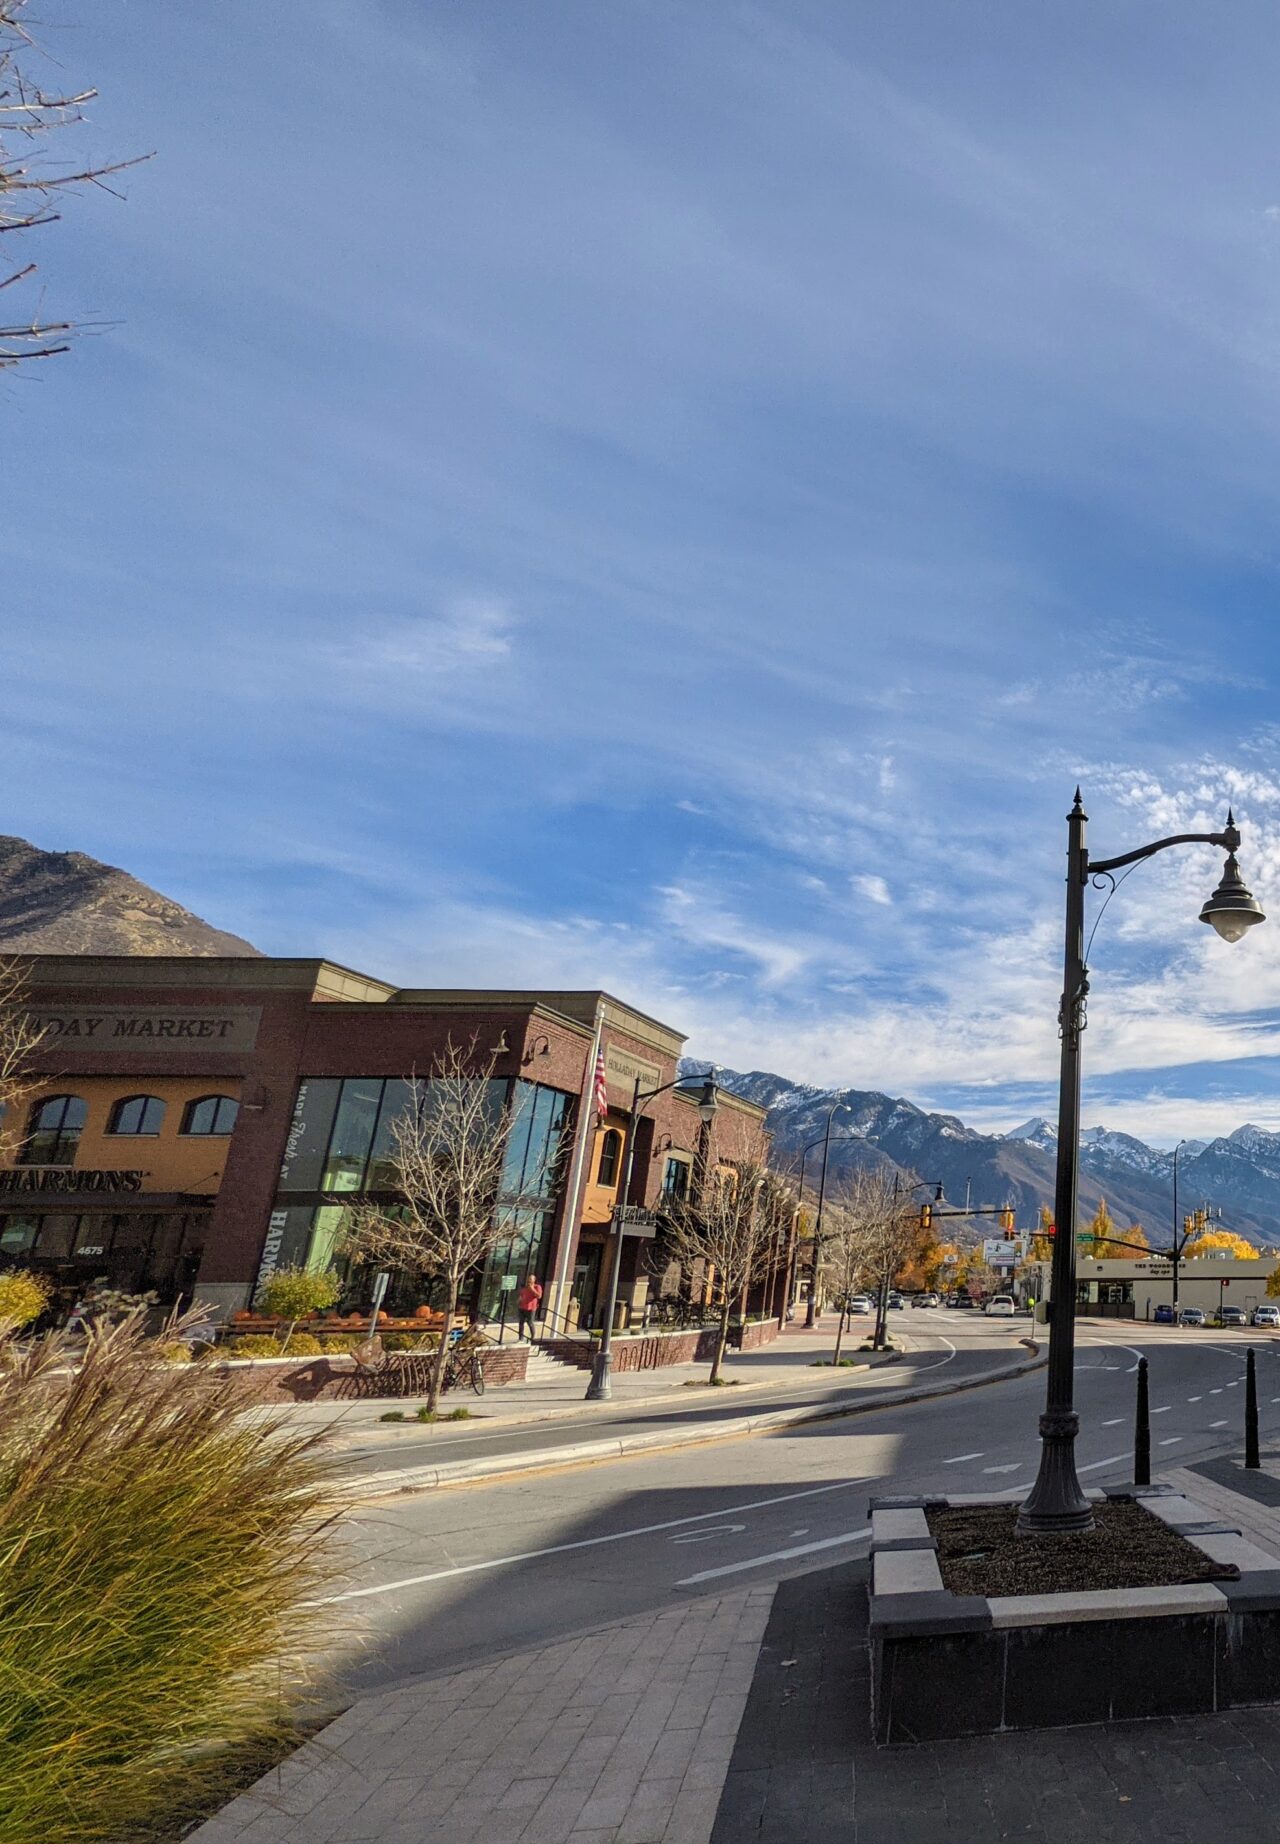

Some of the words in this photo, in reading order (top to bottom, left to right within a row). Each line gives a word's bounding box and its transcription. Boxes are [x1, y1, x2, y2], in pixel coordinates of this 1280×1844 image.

[112, 1017, 235, 1038] MARKET
[292, 1085, 308, 1117] MADE
[0, 1170, 144, 1192] HARMONS
[279, 1165, 288, 1180] AT
[77, 1247, 104, 1255] 4675
